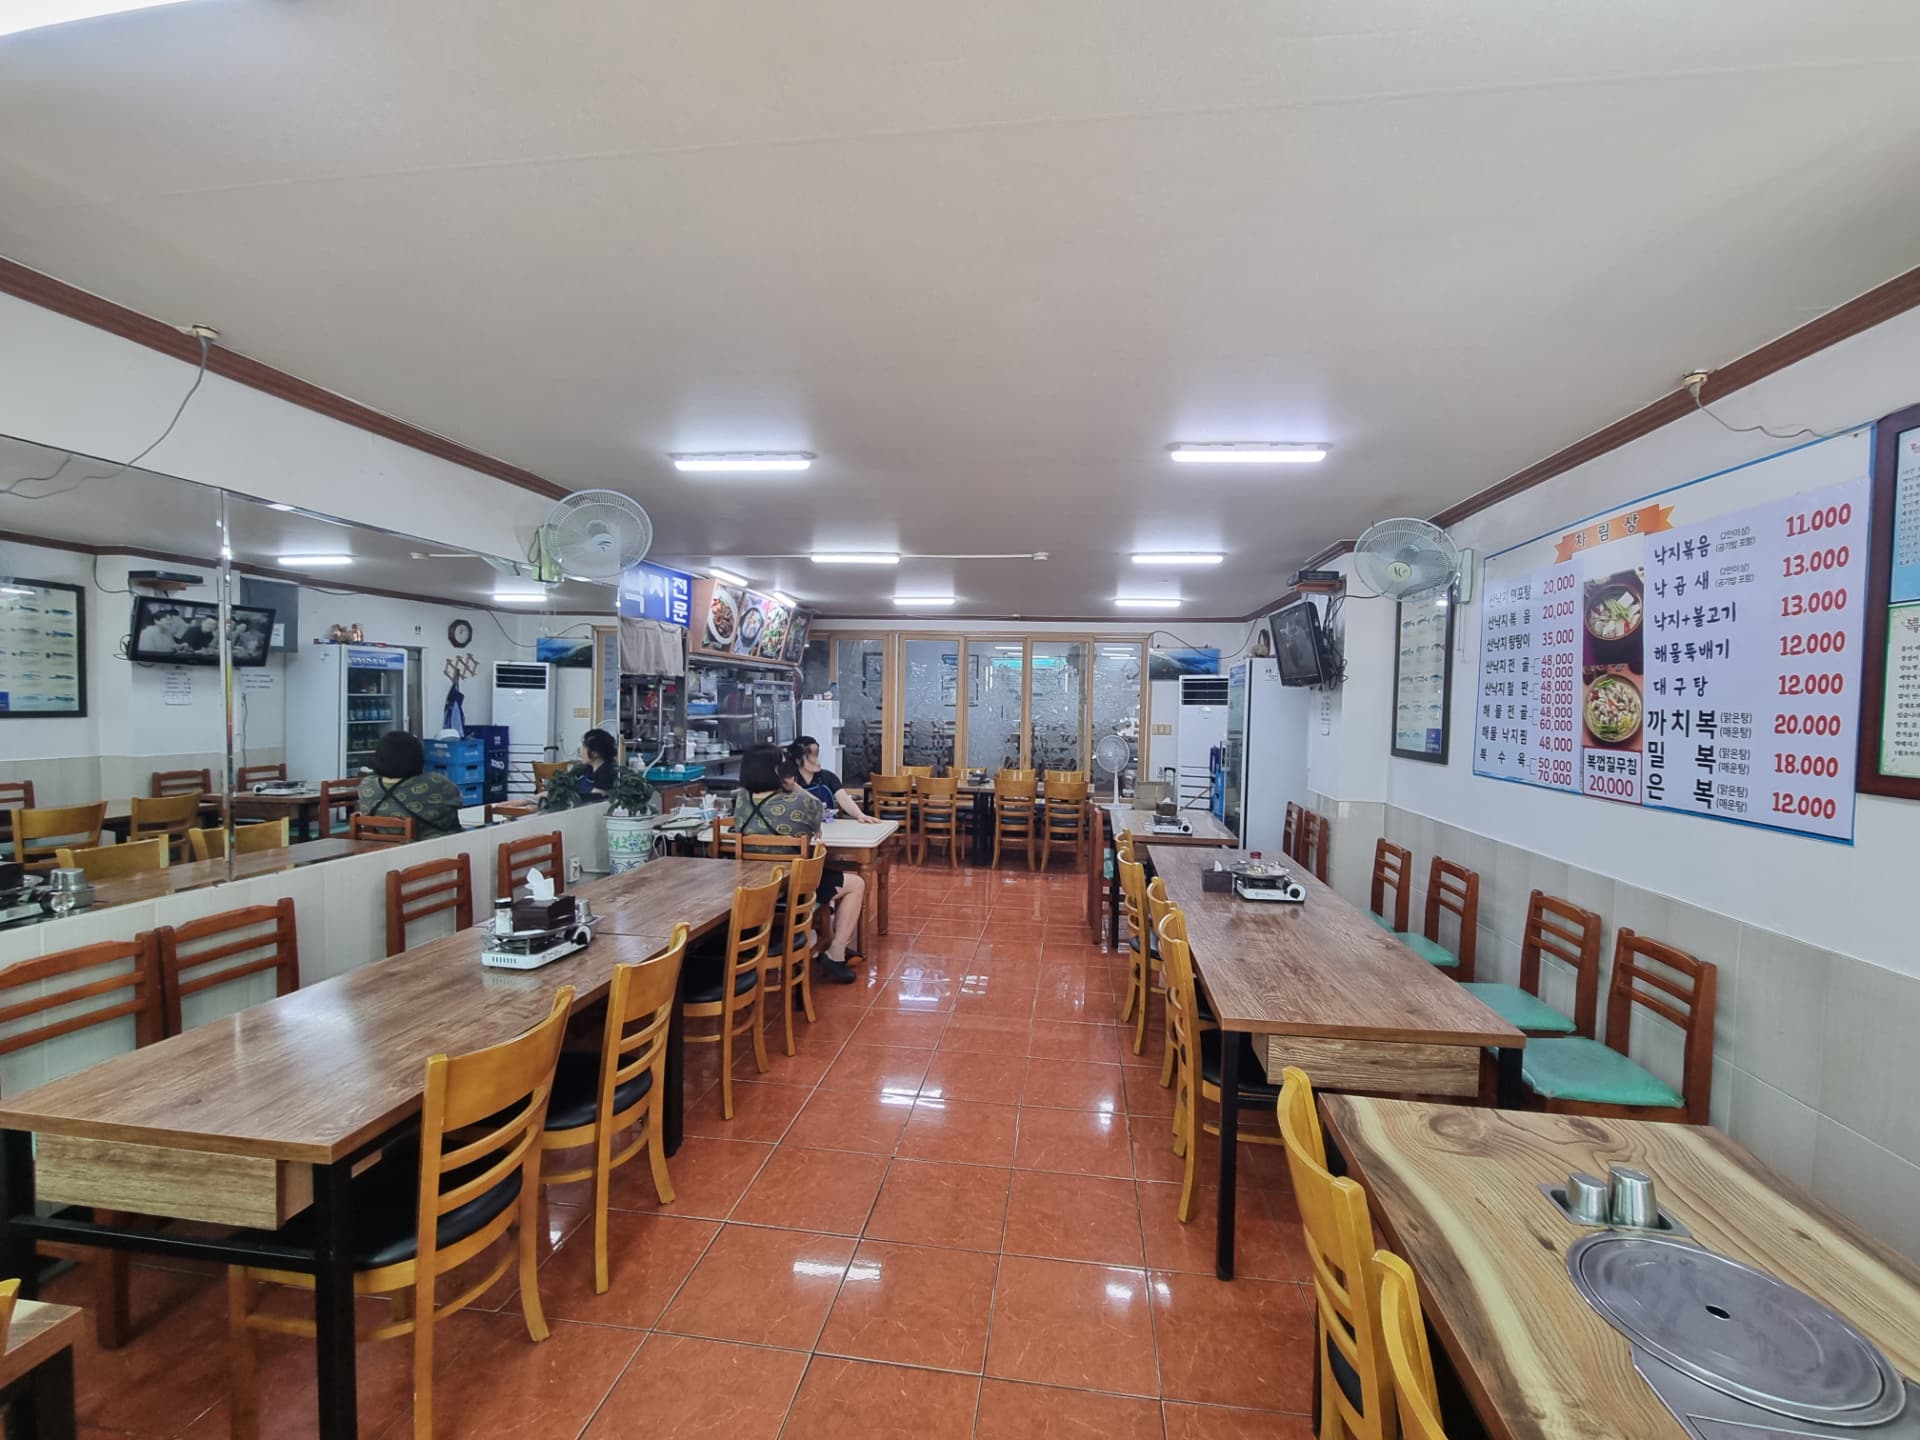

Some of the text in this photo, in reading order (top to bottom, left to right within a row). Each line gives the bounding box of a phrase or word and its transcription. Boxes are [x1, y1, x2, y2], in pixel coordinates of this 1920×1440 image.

[1654, 535, 1711, 566] 낙지볶음
[1783, 546, 1849, 577] 13,000
[1543, 574, 1575, 595] 20,000
[1542, 600, 1574, 620] 20,000
[1781, 588, 1847, 617] 13,000
[1654, 601, 1737, 632] 낙지+불고기
[1542, 628, 1574, 647] 35,000
[1780, 630, 1845, 656] 12,000
[1541, 652, 1574, 667] 48,000
[1653, 638, 1730, 664] 해물뚝배기
[1541, 666, 1573, 680] 60,000
[1541, 680, 1573, 693] 48,000
[1778, 673, 1843, 695] 12,000
[1540, 693, 1572, 706] 60,000
[1540, 706, 1572, 720] 48,000
[1720, 711, 1753, 725] (맑은탕)
[1540, 719, 1572, 732] 60,000
[1719, 726, 1752, 739] (매운탕)
[1774, 713, 1841, 736] 20,000
[1539, 736, 1572, 752] 48,000
[1718, 747, 1751, 761] (맑은탕)
[1538, 757, 1572, 773] 50,000
[1587, 754, 1638, 776] 복껍질무침
[1718, 762, 1750, 776] (매운탕)
[1774, 752, 1839, 778] 18,000
[1538, 769, 1571, 786] 70,000
[1589, 774, 1634, 798] 20,000
[1717, 783, 1749, 799] (맑은탕)
[1716, 798, 1748, 813] (매운탕)
[1772, 791, 1836, 820] 12,000
